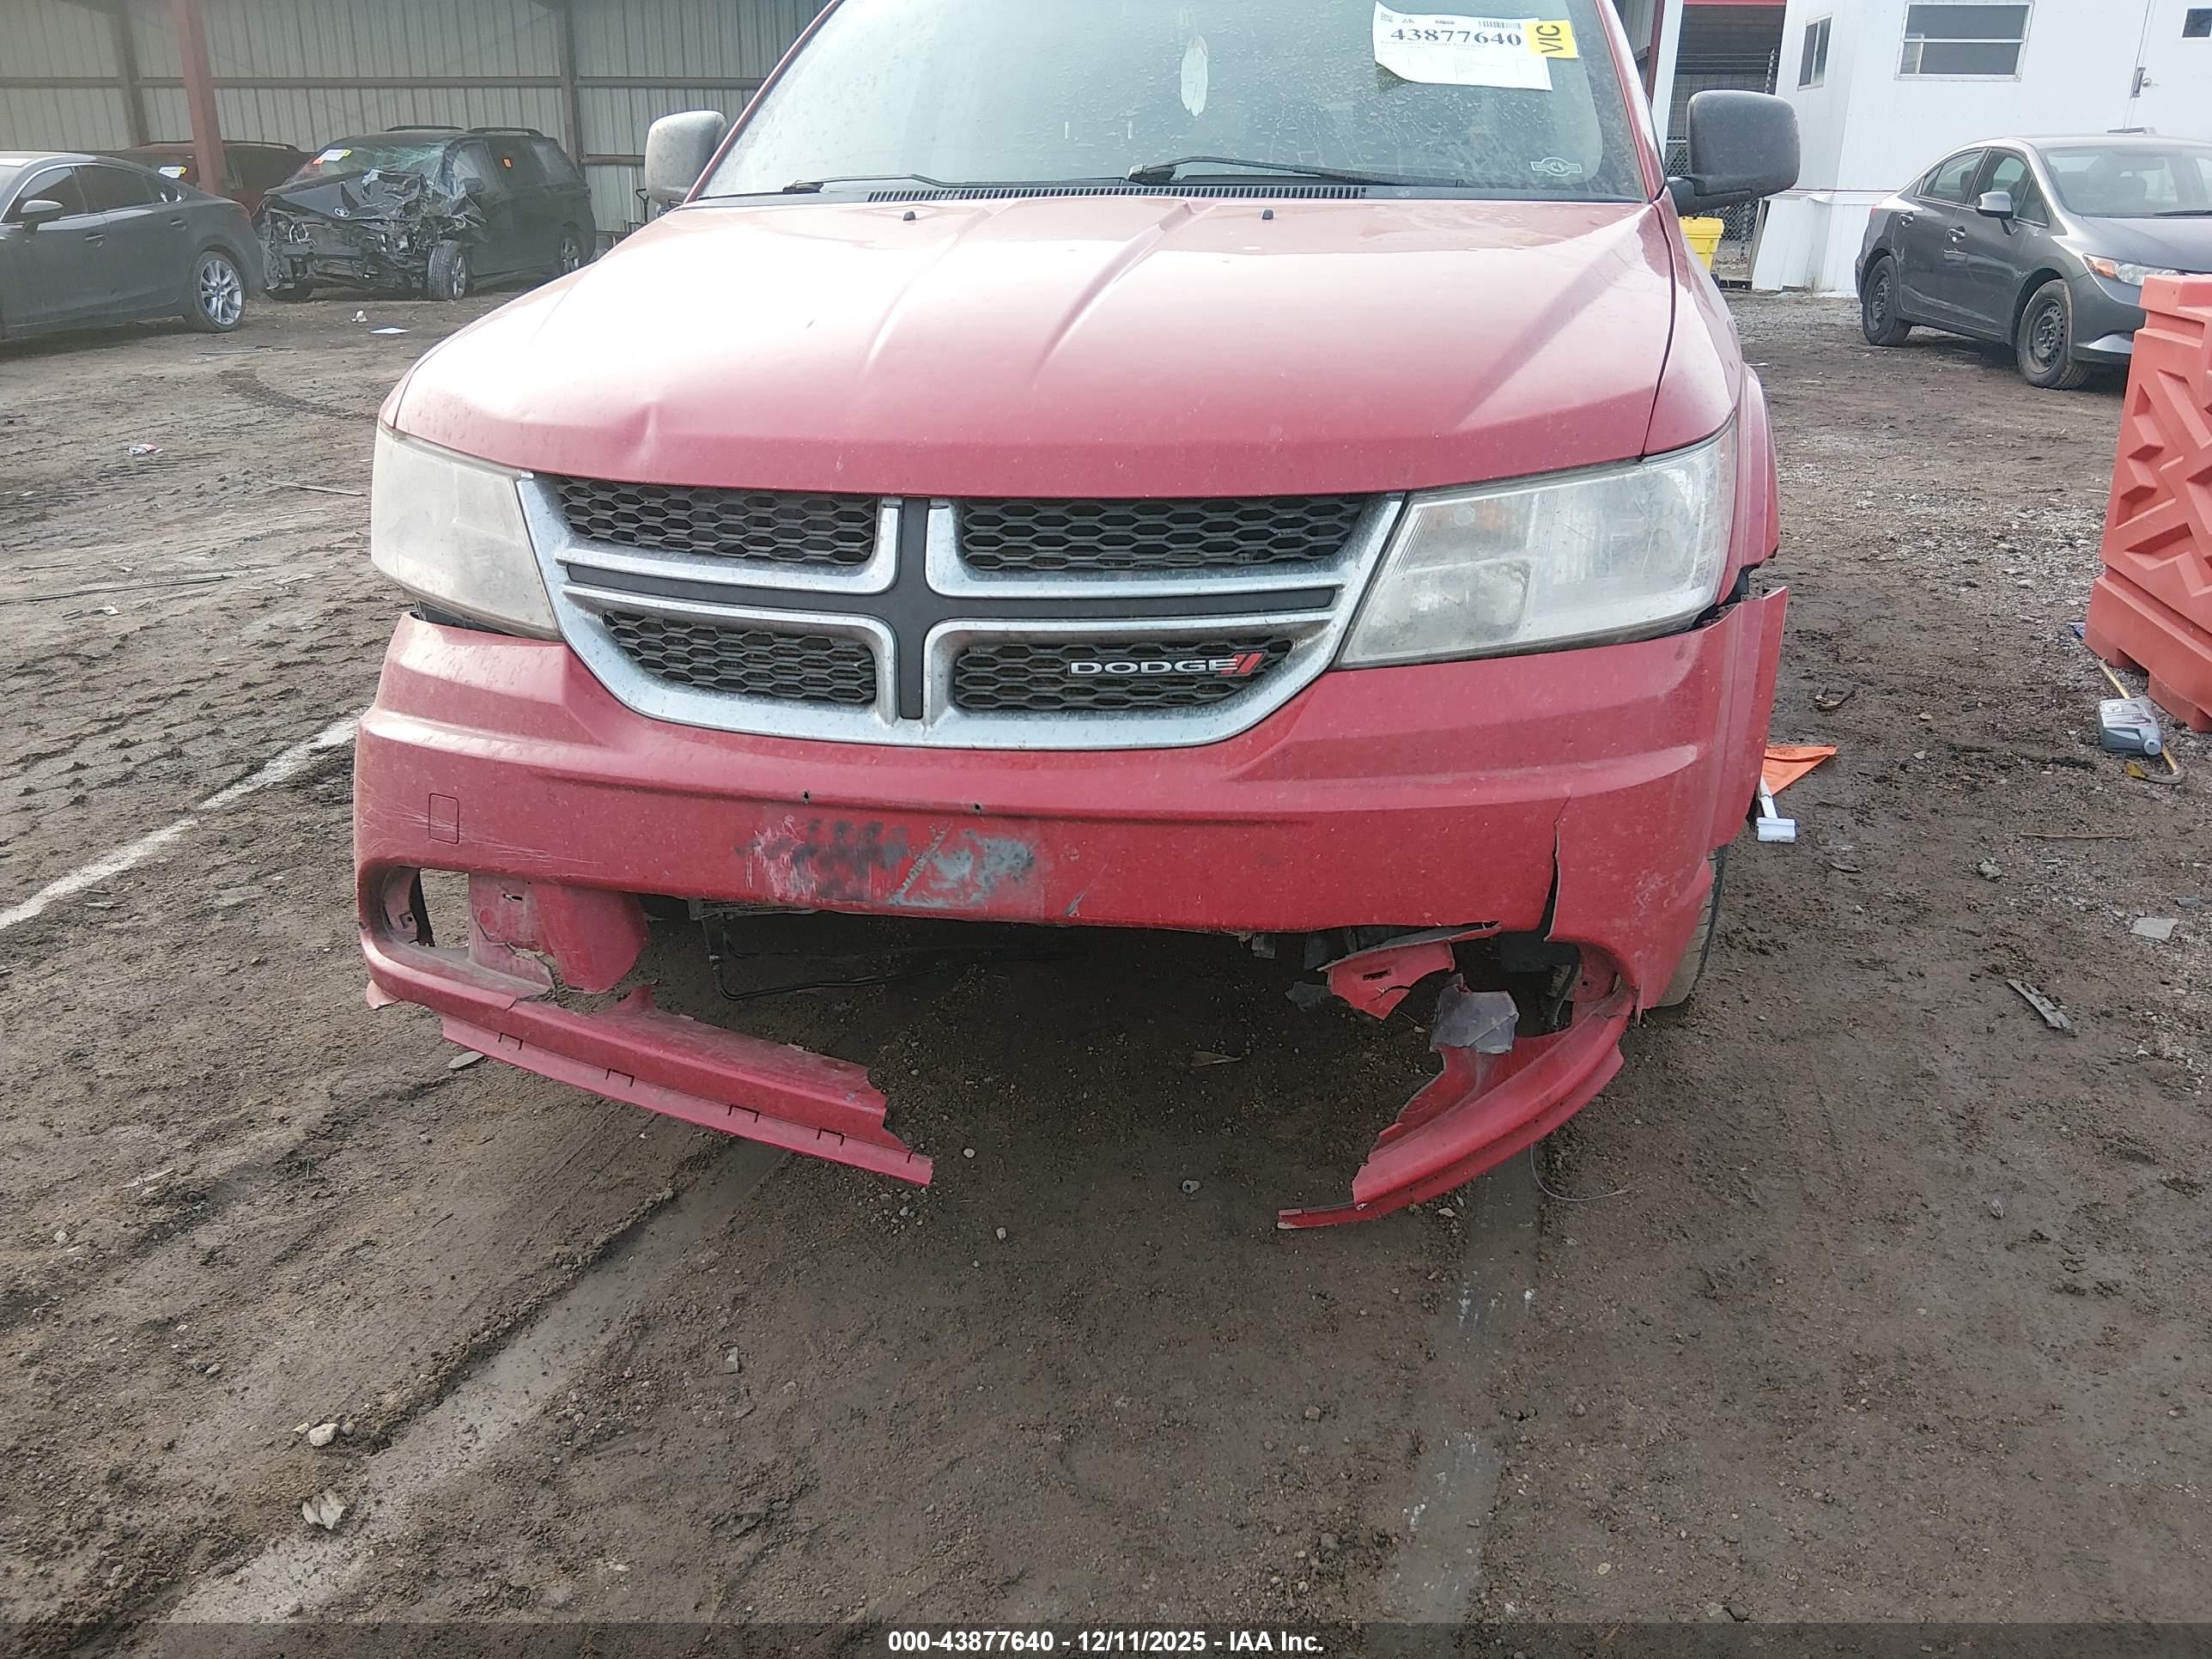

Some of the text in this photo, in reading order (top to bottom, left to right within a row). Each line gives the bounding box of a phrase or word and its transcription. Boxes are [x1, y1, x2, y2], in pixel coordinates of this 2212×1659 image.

[1390, 28, 1522, 46] 43877640
[1535, 24, 1565, 53] VIC
[1070, 658, 1238, 674] DODGE
